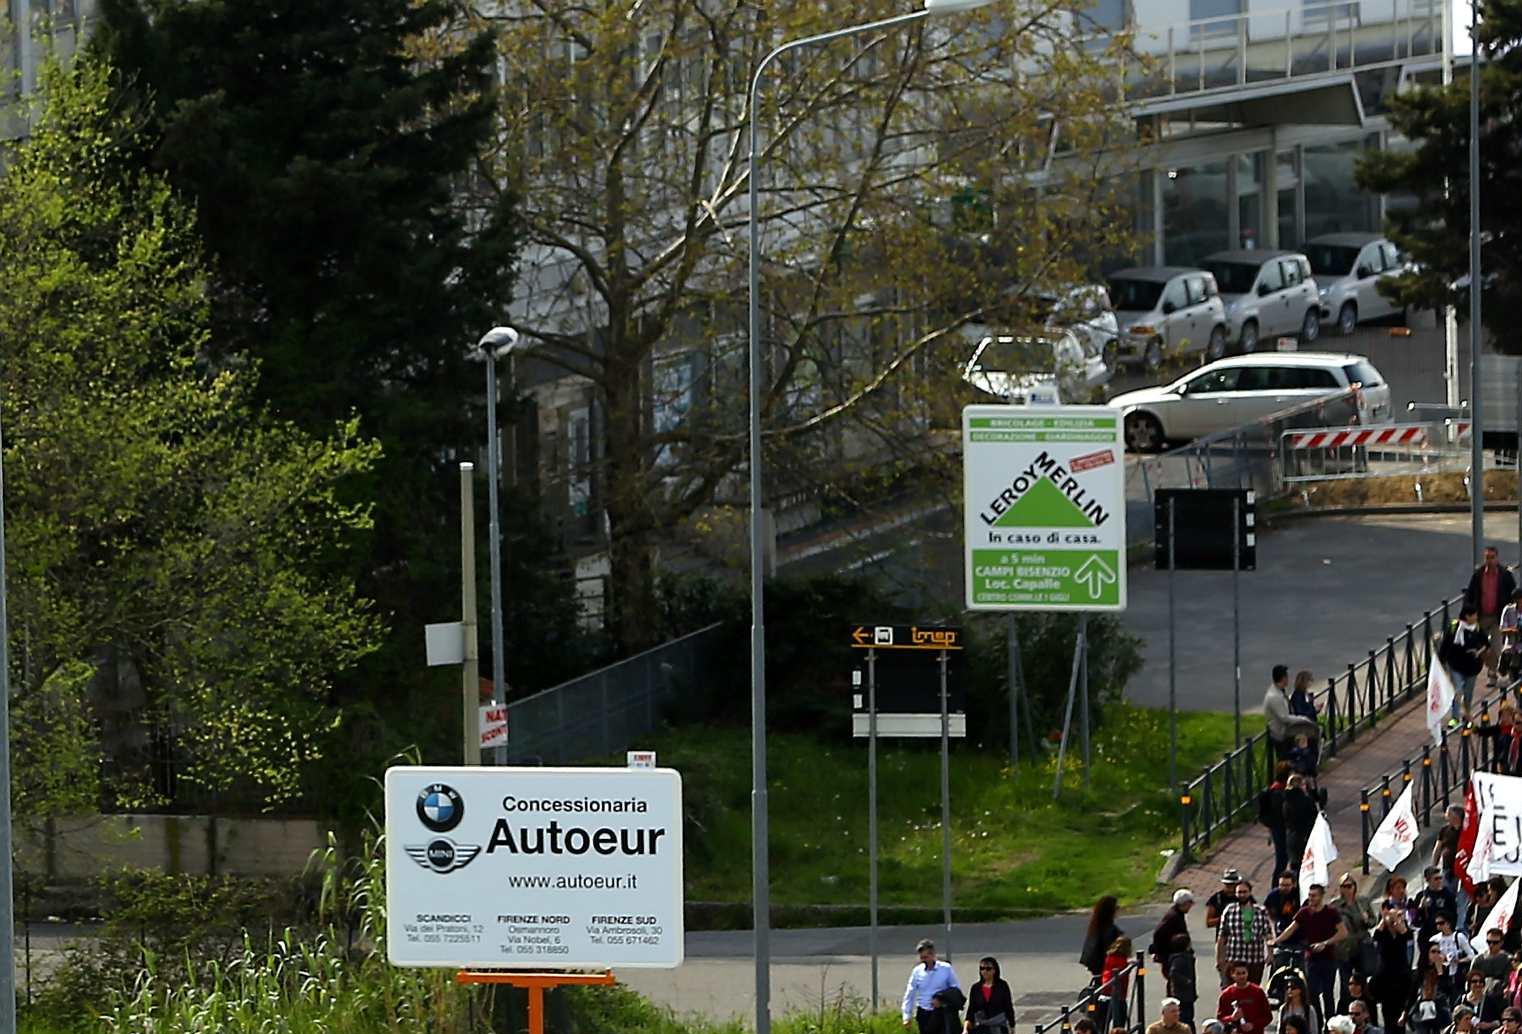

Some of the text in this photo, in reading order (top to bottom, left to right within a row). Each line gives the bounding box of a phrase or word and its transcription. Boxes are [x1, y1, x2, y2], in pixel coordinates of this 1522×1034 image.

[980, 450, 1110, 528] LEROY MERLIN
[988, 532, 1001, 544] In
[1007, 534, 1041, 544] caso
[1047, 532, 1060, 544] di
[1011, 554, 1019, 564] 5
[1022, 554, 1045, 564] min
[975, 566, 1014, 577] CAMPI
[502, 795, 648, 814] Concessionaria
[485, 818, 666, 856] Autoeur
[509, 873, 638, 890] www.autoeur.it
[416, 914, 472, 924] SCANDICCI
[497, 915, 571, 925] FIRENZE NORD
[592, 916, 657, 926] FIRENZE SUD
